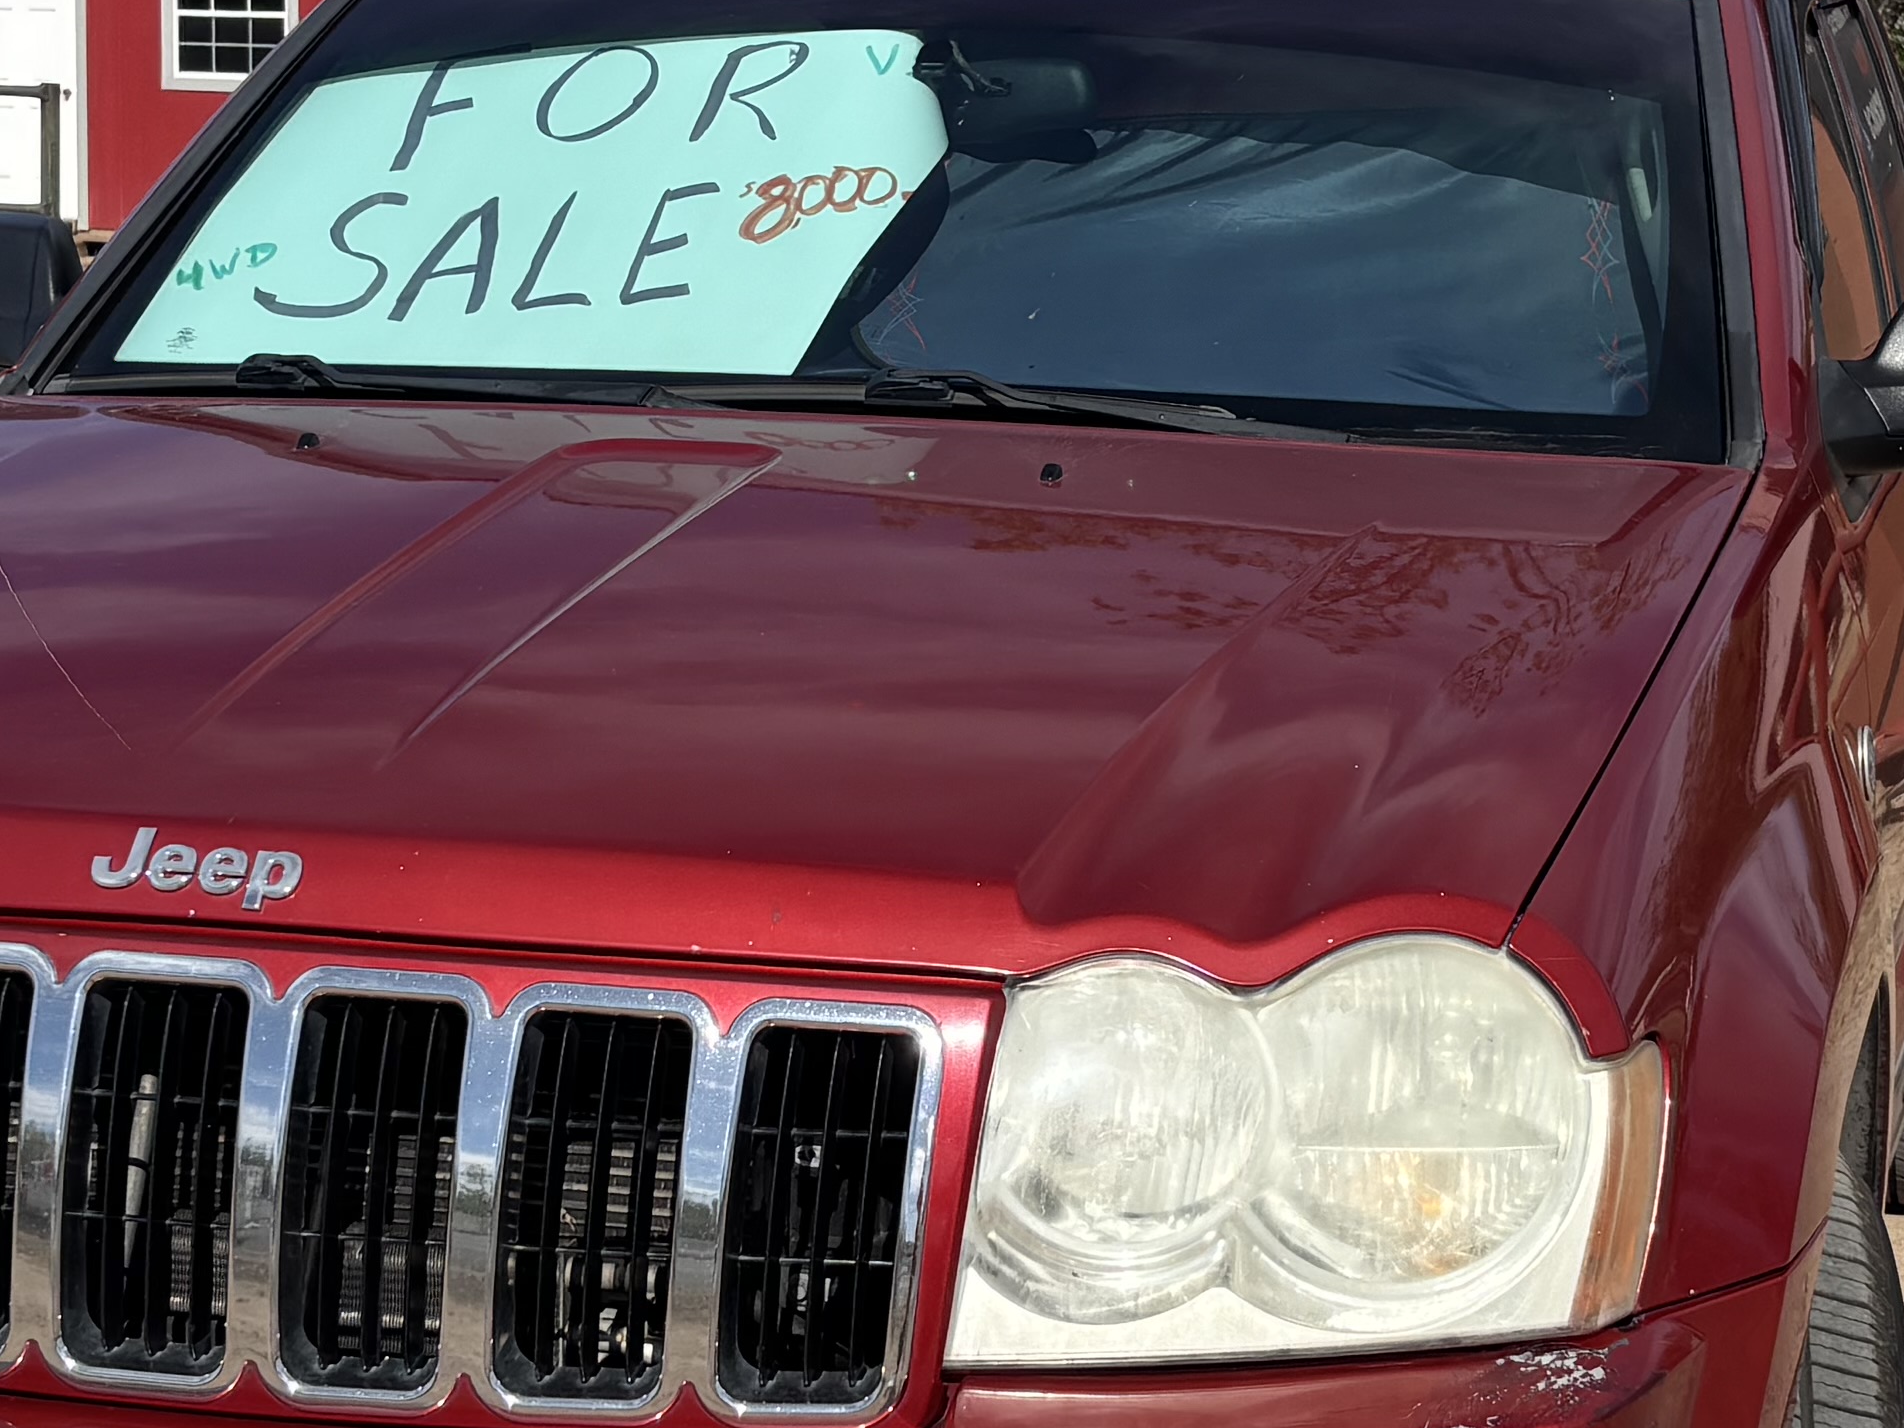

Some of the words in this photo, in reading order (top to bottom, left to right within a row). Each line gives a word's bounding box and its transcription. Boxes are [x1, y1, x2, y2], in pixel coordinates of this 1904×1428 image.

[866, 43, 914, 77] V
[389, 40, 809, 172] FOR
[176, 242, 277, 291] 4WD
[253, 181, 720, 322] SALE
[90, 827, 303, 911] Jeep
